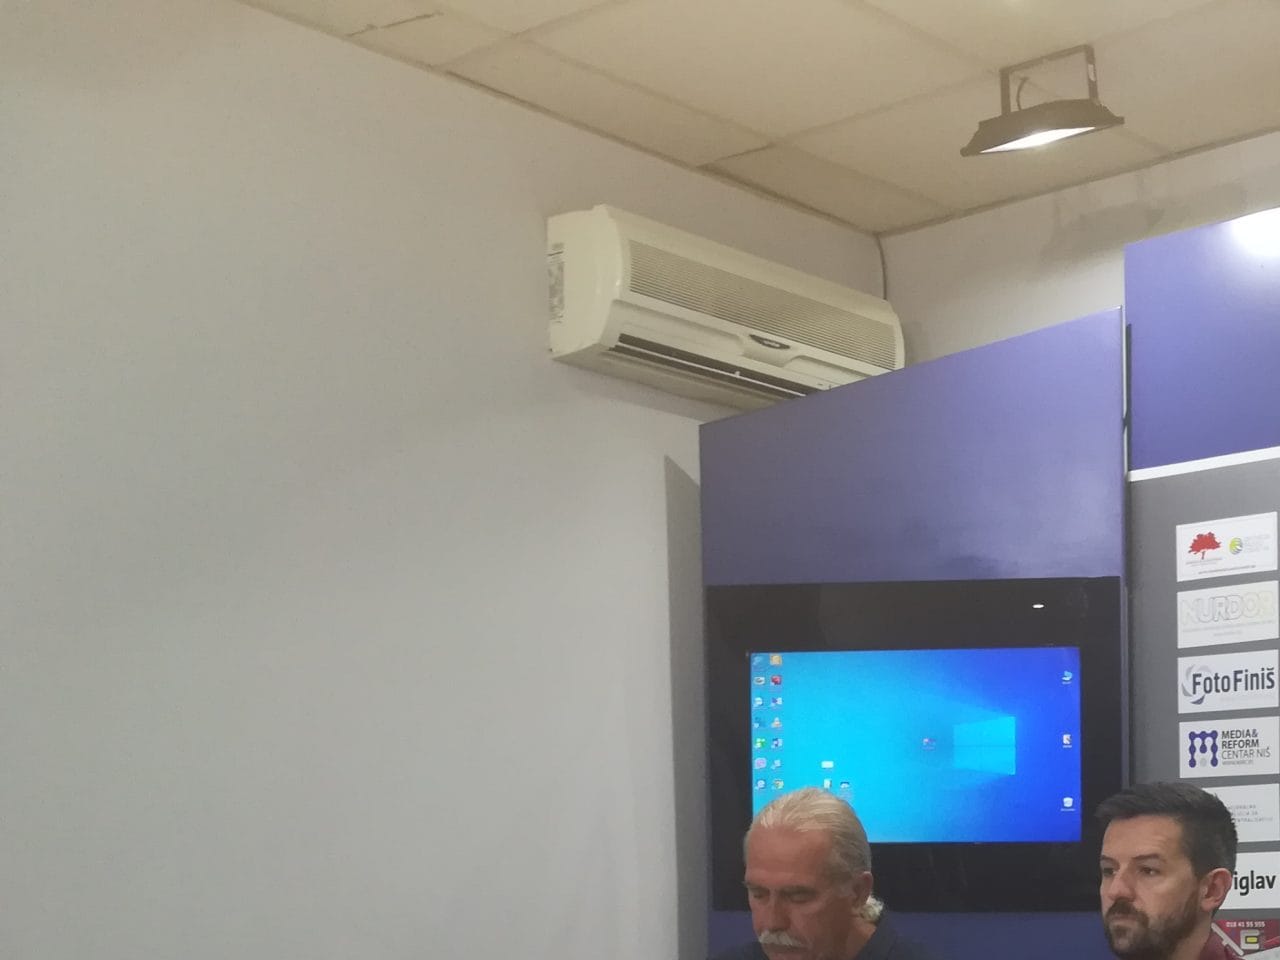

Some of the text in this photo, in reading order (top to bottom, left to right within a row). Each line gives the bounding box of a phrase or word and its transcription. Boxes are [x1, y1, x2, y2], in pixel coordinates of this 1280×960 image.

[1221, 729, 1258, 739] MEDIA&
[1221, 739, 1259, 749] REFORM
[1221, 749, 1255, 760] CENTAR
[1233, 870, 1276, 896] iglav
